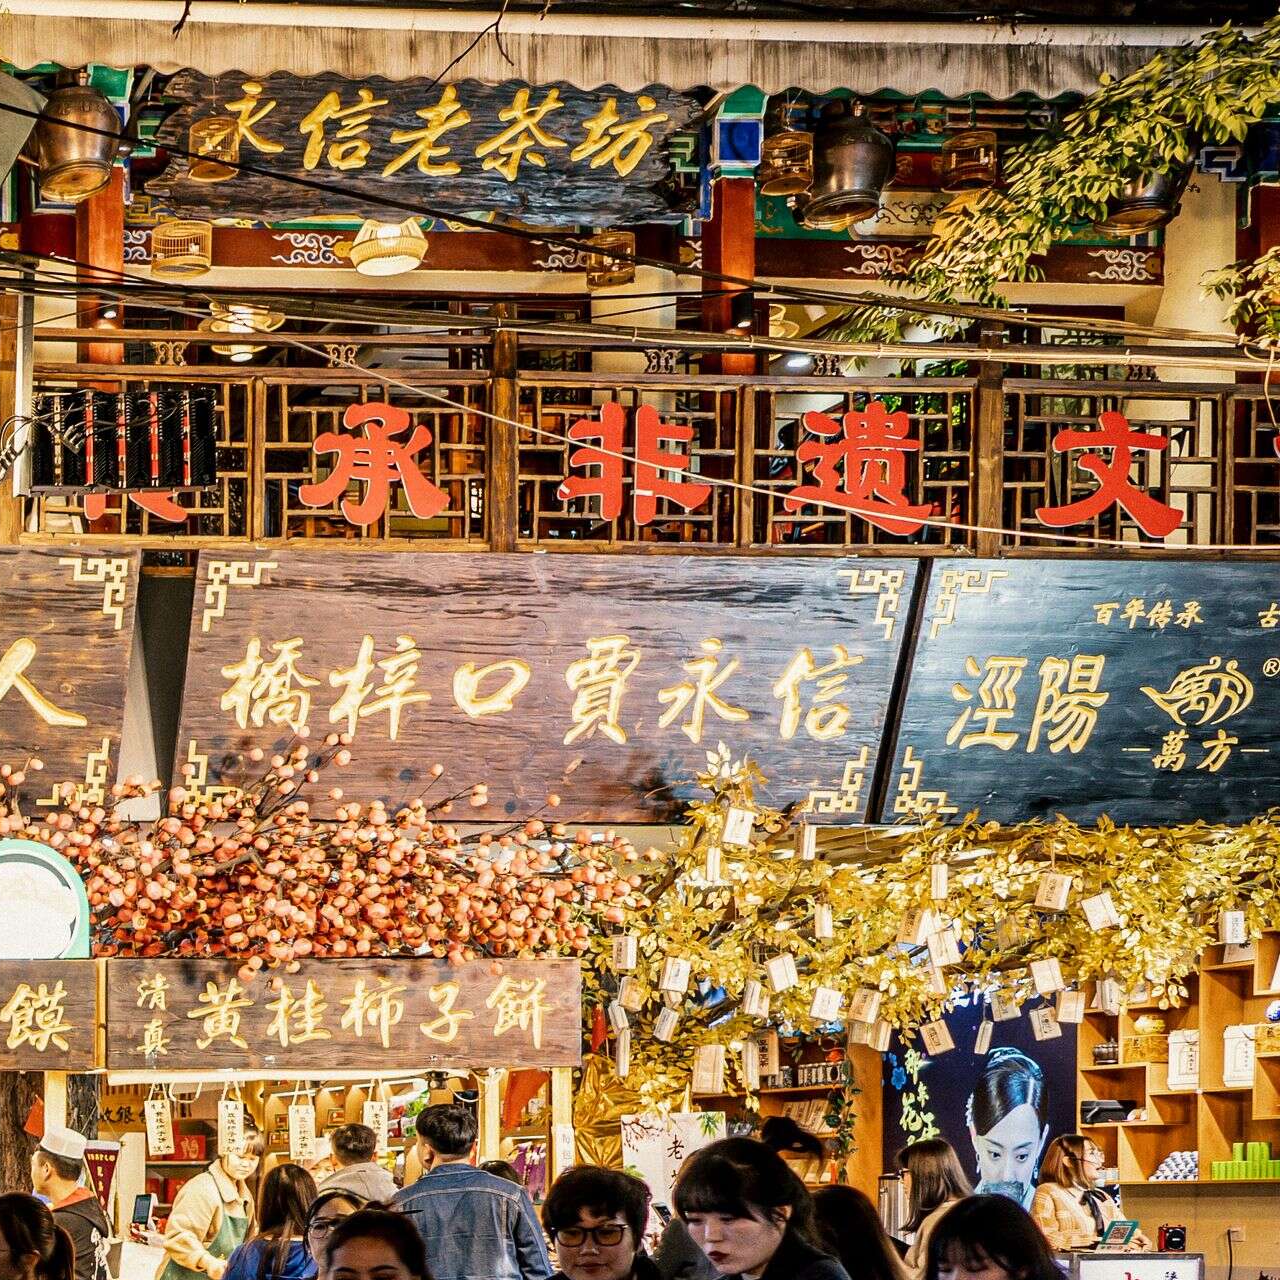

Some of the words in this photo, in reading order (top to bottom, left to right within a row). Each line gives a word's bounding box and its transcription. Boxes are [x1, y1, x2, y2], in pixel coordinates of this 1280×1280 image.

[225, 80, 670, 183] 永信老茶坊
[1093, 598, 1204, 629] 百年传承
[220, 634, 863, 745] 橋梓口賈永信
[946, 655, 1110, 754] 涇陽
[1151, 728, 1239, 773] 萬方
[137, 973, 171, 1056] 清真
